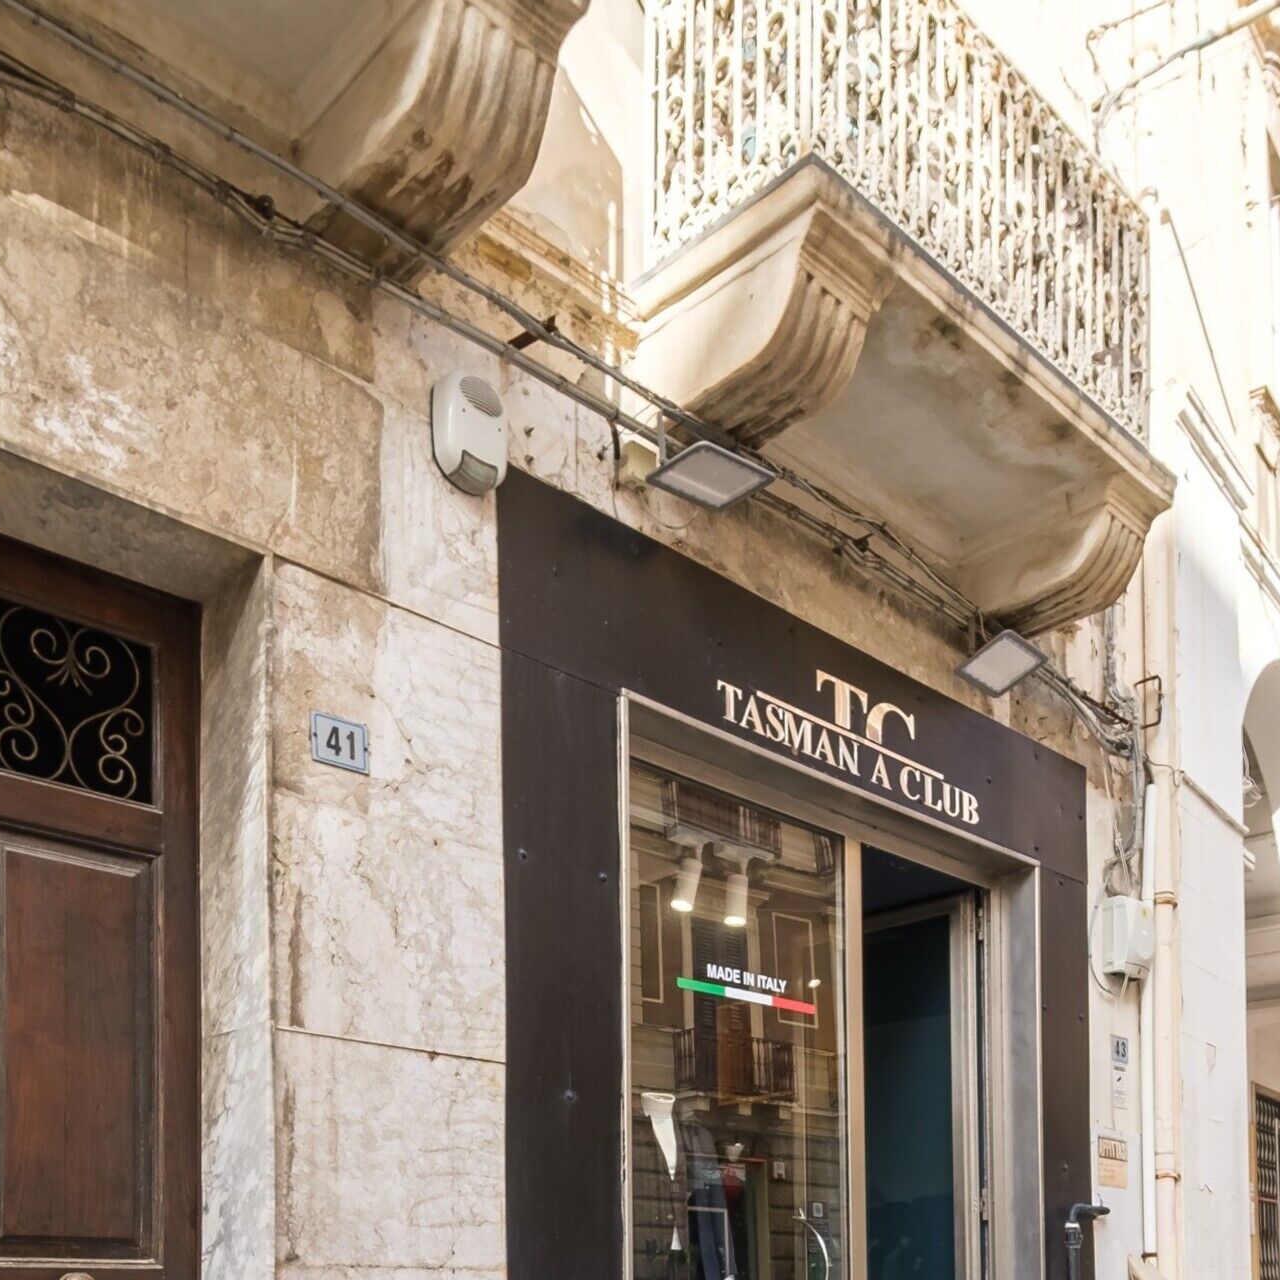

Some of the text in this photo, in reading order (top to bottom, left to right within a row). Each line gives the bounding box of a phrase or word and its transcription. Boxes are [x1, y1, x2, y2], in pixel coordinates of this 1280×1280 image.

[326, 726, 356, 760] 41
[717, 679, 980, 825] TASMAN A CLUB
[706, 963, 787, 993] MADE IN ITALY
